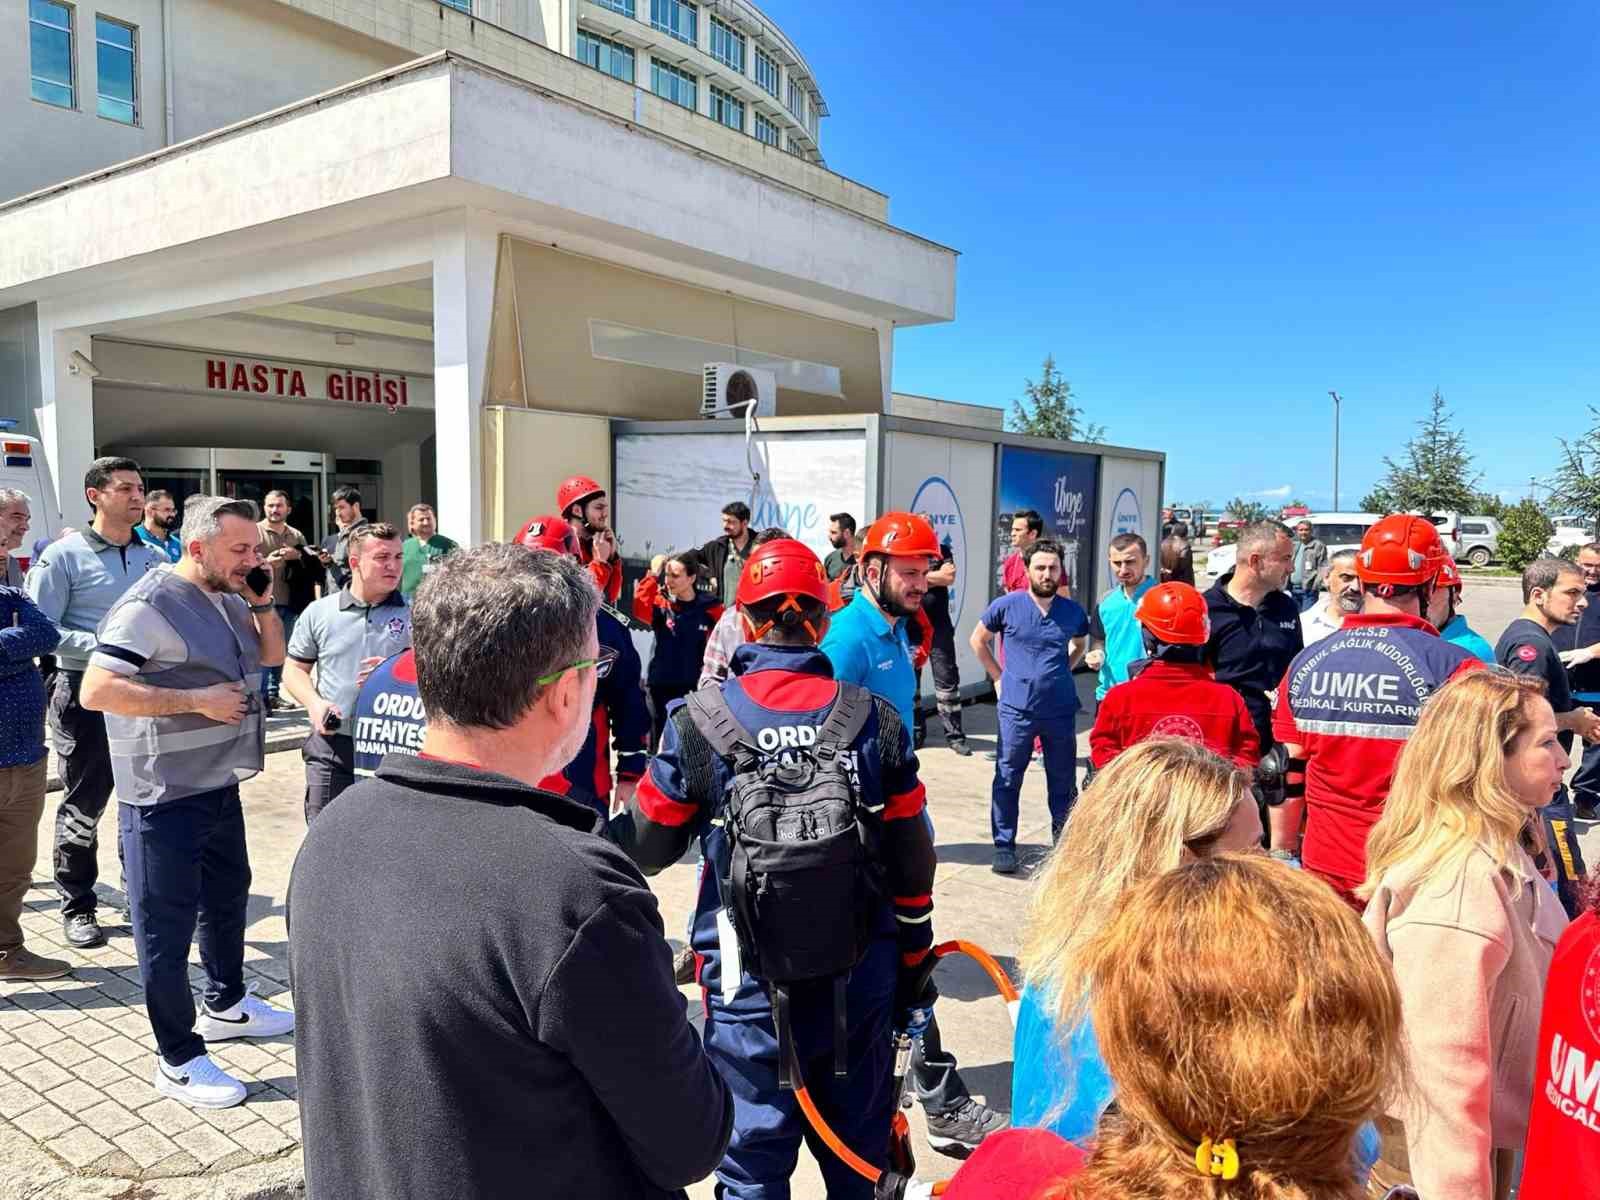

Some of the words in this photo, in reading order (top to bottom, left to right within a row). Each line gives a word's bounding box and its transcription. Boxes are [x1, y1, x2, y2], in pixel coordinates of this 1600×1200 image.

[206, 359, 307, 397] HASTA
[327, 368, 408, 413] GİRİŞİ
[1289, 649, 1329, 696] İSTANBUL
[1330, 637, 1374, 653] SAĞLIK
[1310, 671, 1400, 701] UMKE
[356, 740, 387, 755] ARAMA
